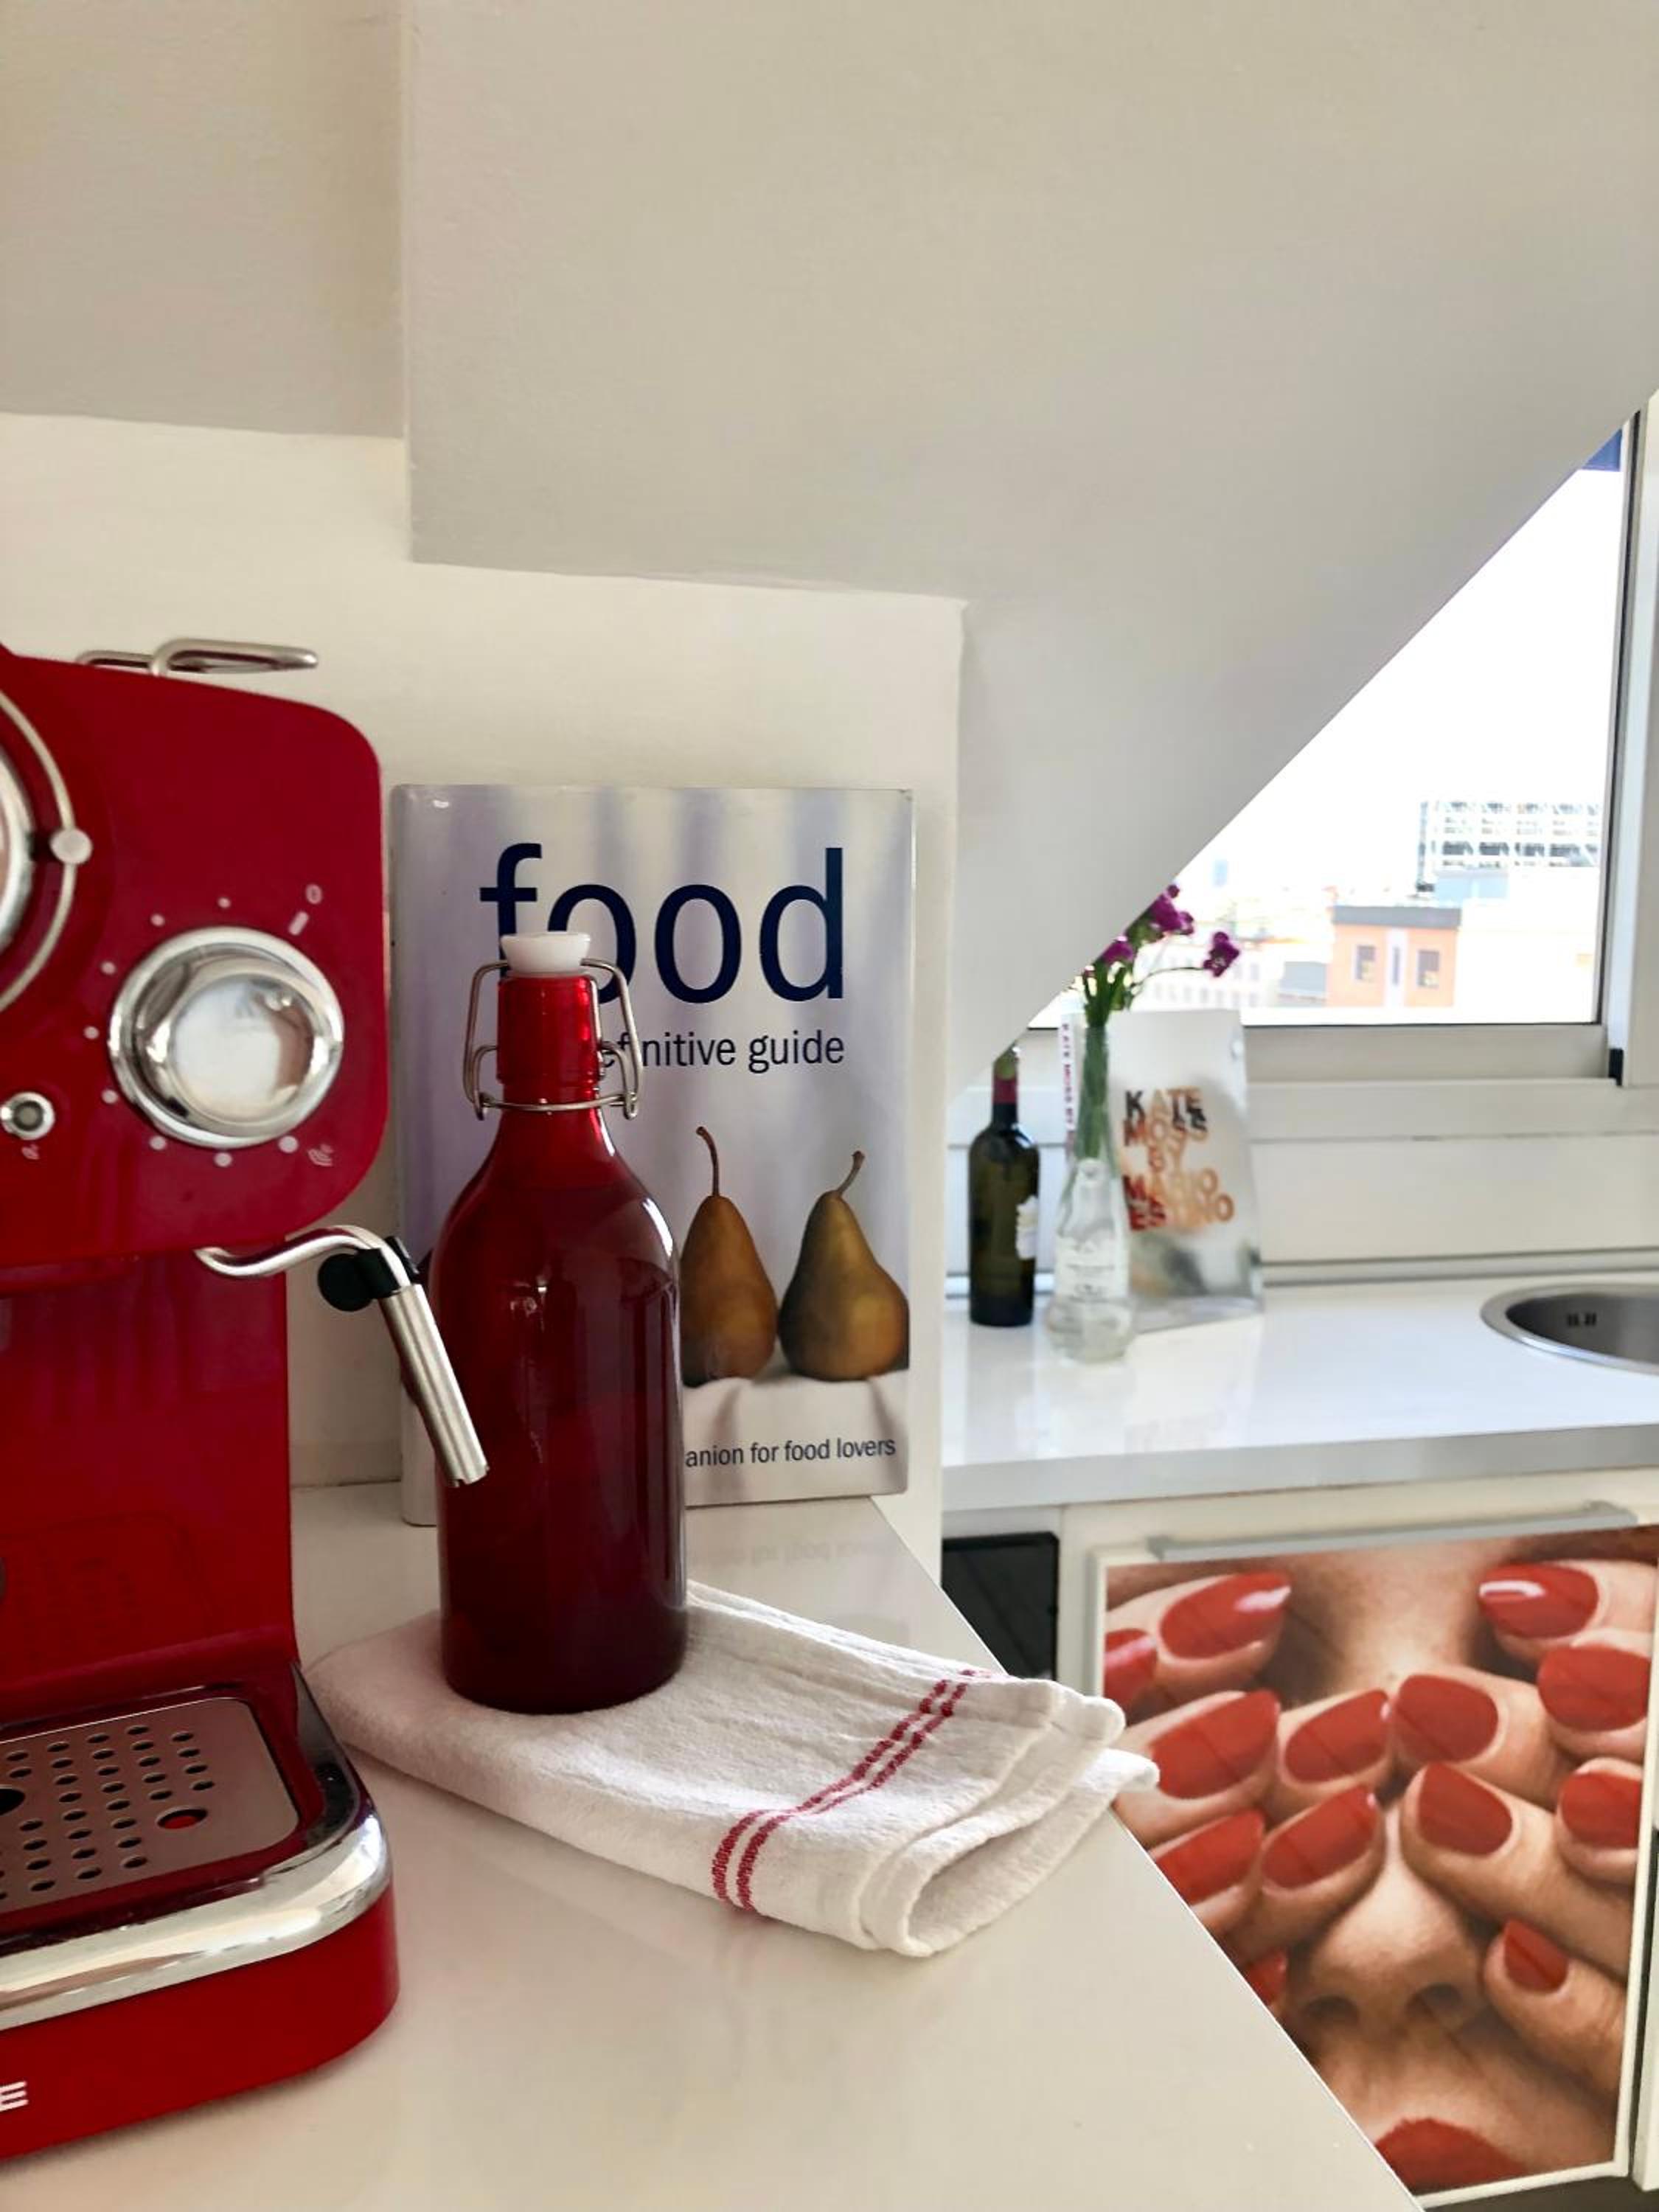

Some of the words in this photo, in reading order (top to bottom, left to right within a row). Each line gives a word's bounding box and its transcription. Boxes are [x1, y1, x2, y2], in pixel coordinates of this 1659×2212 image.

[479, 843, 844, 1004] food
[601, 1032, 736, 1068] efnitive
[748, 1030, 844, 1074] guide
[686, 1445, 744, 1467] anion
[751, 1442, 779, 1464] for
[785, 1439, 830, 1461] food
[837, 1437, 896, 1458] lovers
